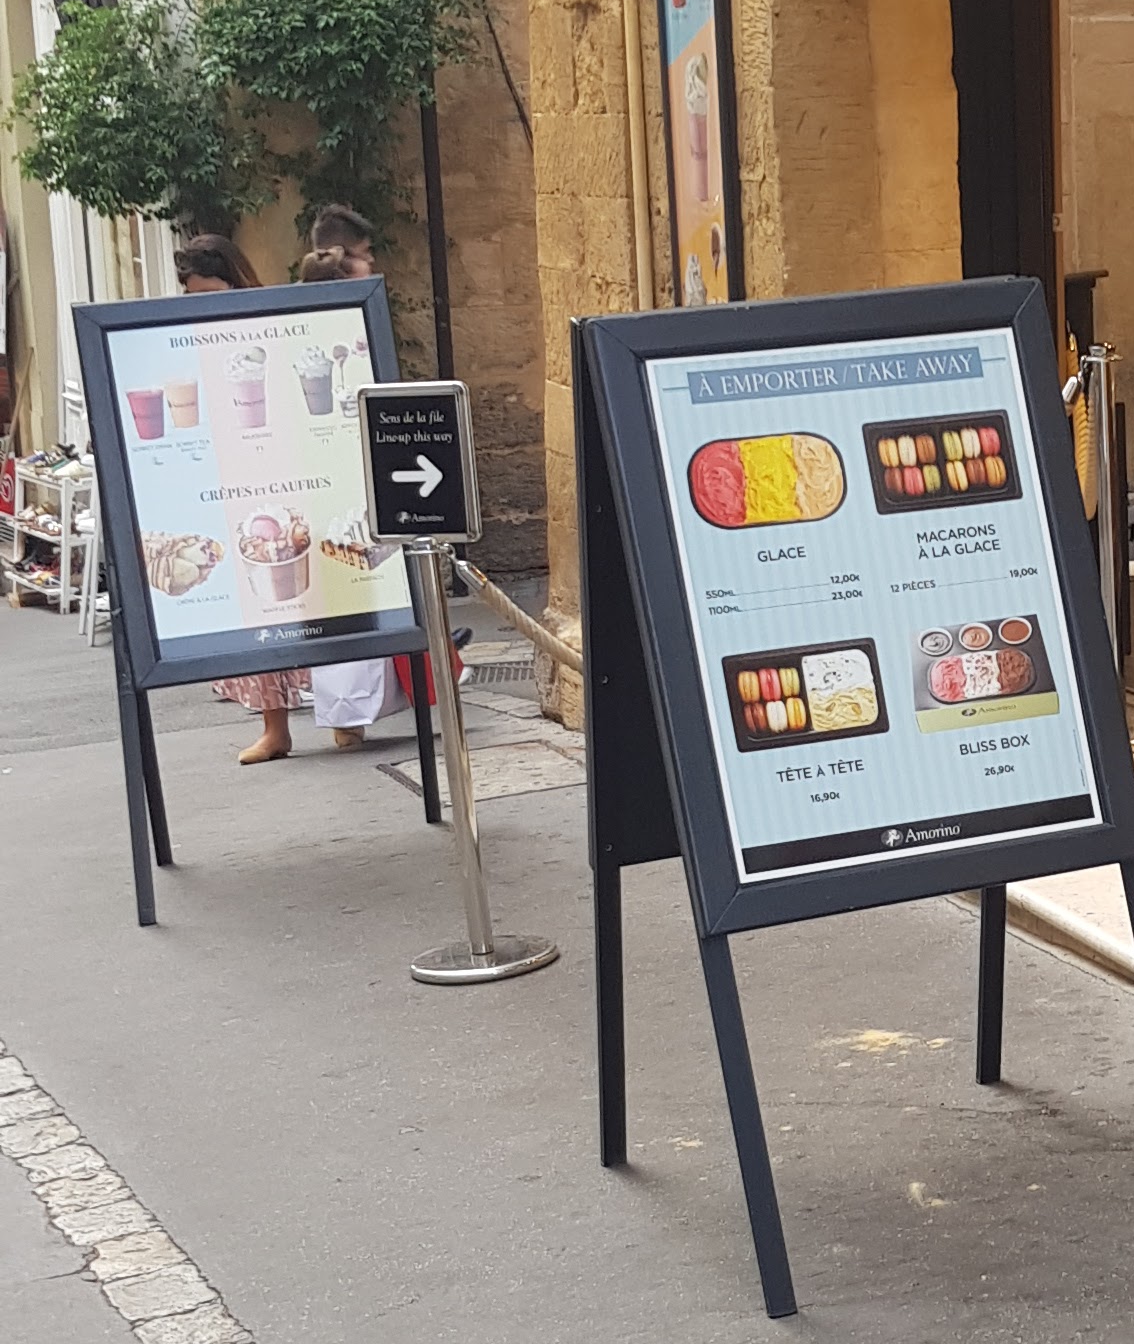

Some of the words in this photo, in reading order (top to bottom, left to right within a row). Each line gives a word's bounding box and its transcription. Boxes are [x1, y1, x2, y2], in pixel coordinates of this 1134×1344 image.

[169, 330, 238, 349] BOISSONS
[249, 331, 263, 342] LA
[263, 323, 311, 340] GLACE
[698, 372, 714, 398] À
[719, 365, 837, 396] EMPORTER
[850, 358, 908, 384] TAKE
[915, 353, 973, 379] AWAY
[379, 411, 400, 424] Sens
[402, 410, 415, 423] de
[416, 410, 427, 423] la
[428, 410, 445, 425] file
[413, 429, 432, 443] this
[433, 432, 454, 445] way
[199, 485, 253, 503] CRÊPES
[254, 487, 267, 497] ET
[269, 476, 332, 495] GAUFRES
[916, 523, 996, 544] MACARONS
[757, 546, 807, 563] GLACE
[918, 545, 929, 560] À
[931, 545, 951, 558] LA
[954, 539, 1001, 556] GLACE
[890, 583, 900, 594] 12
[274, 624, 323, 642] Amorino
[959, 739, 998, 756] BLISS
[1000, 734, 1031, 750] BOX
[776, 766, 813, 783] TÊTE
[816, 764, 826, 778] À
[828, 759, 865, 776] TÊTE
[984, 764, 1015, 776] 26,90€
[810, 791, 840, 803] 16,90€
[905, 822, 961, 843] Amorino
